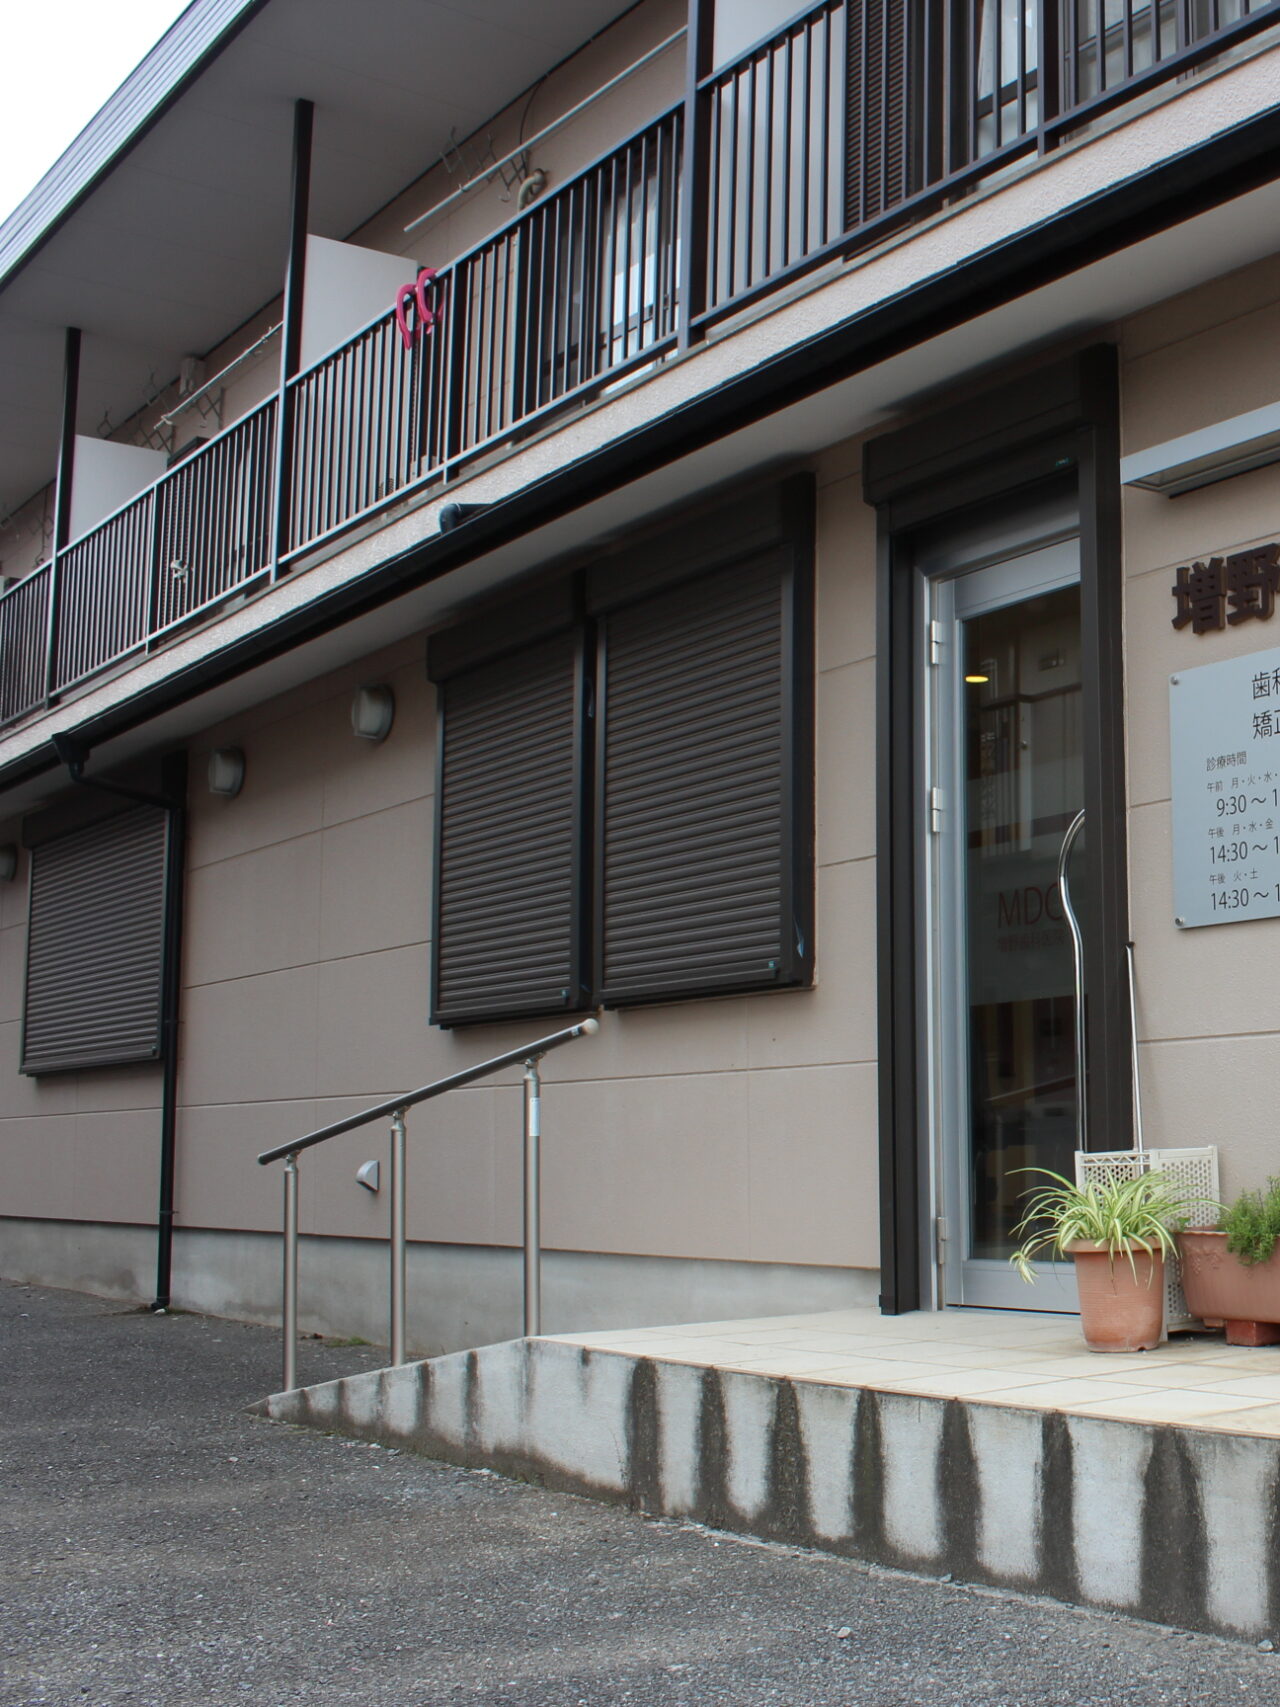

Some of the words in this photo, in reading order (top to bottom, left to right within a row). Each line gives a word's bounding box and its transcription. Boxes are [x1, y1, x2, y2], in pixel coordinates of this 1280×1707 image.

[1206, 751, 1247, 772] 診療時間
[997, 881, 1064, 929] MDC
